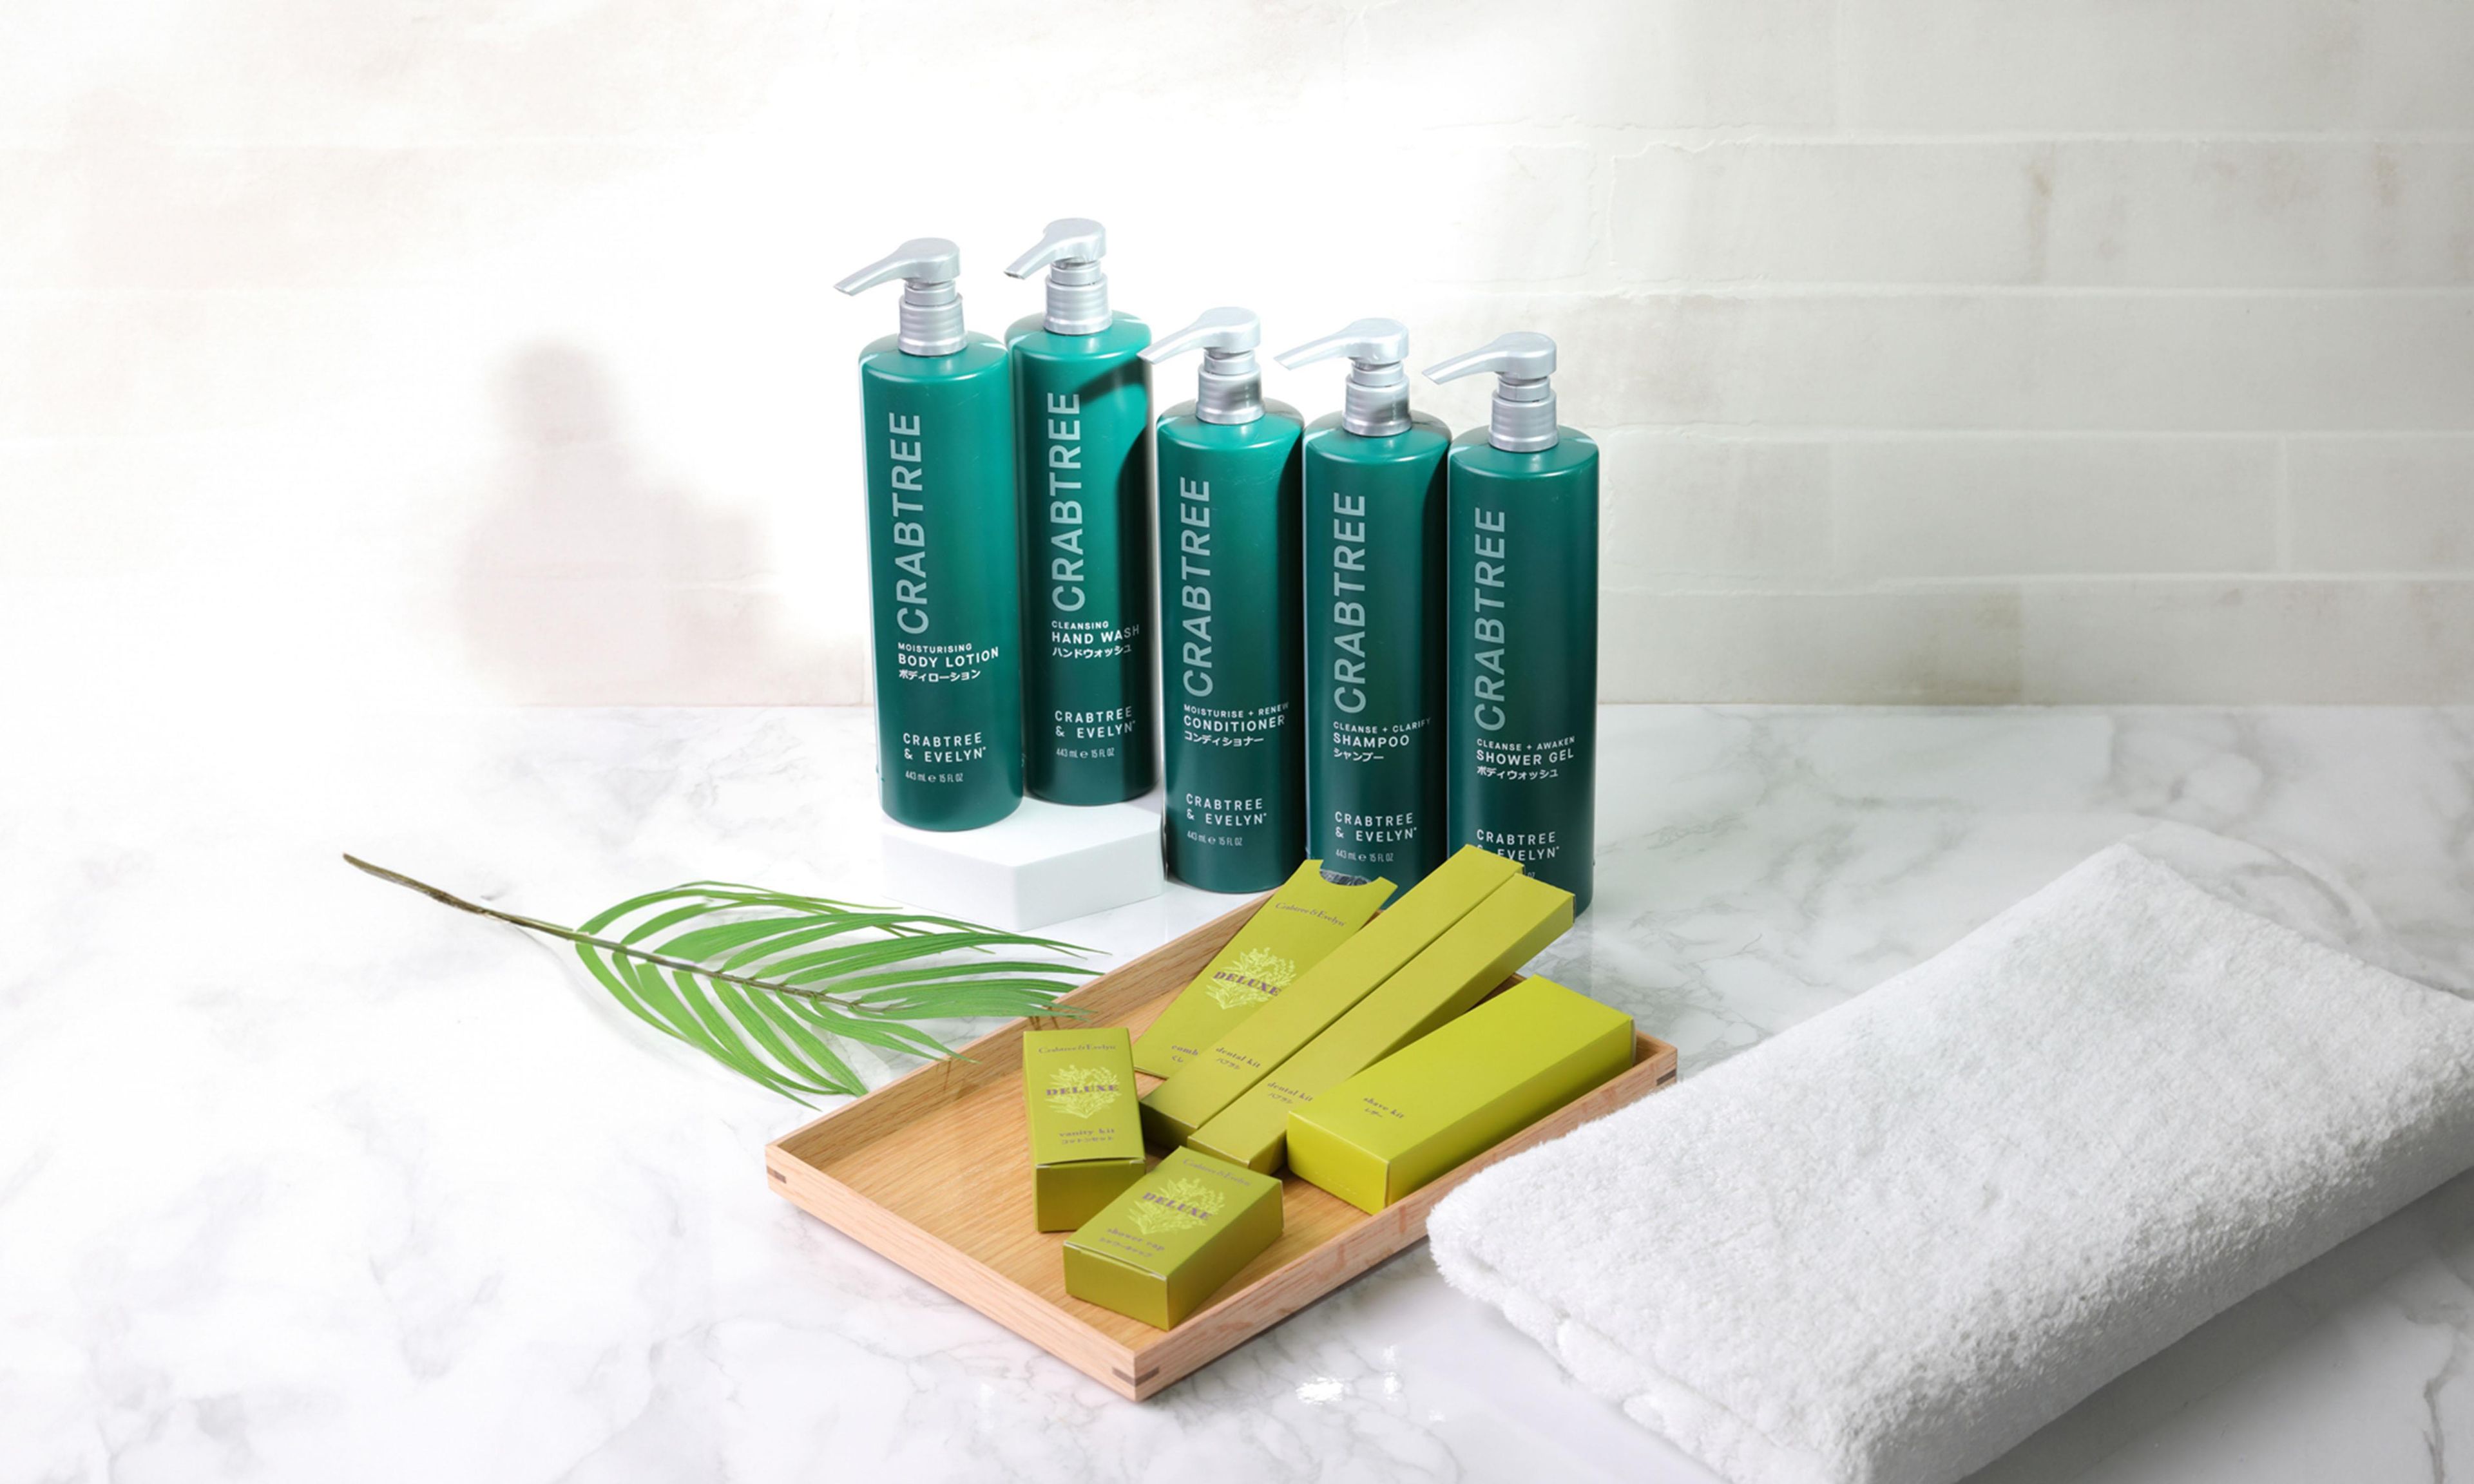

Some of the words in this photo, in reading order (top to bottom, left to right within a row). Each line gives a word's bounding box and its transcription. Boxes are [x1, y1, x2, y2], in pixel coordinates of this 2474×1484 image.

[1048, 392, 1086, 612] CRABTREE
[889, 412, 929, 634] CRABTREE
[1180, 477, 1213, 698] CRABTREE
[1334, 492, 1366, 714] CRABTREE
[1051, 620, 1109, 630] CLEANSING
[1475, 508, 1506, 732] CRABTREE
[1051, 631, 1094, 645] HAND
[1100, 624, 1140, 643] WASH
[897, 642, 972, 654] MOISTURISING
[898, 653, 938, 668] BODY
[946, 646, 999, 668] LOTION
[1052, 645, 1132, 659] ハンドウォッシュ
[899, 669, 981, 683] ボディローション
[1055, 706, 1132, 723] CRABTREE
[1184, 703, 1244, 718] MOISTURISE
[1258, 701, 1289, 716] RENEW
[1055, 725, 1065, 737] &
[1077, 721, 1133, 739] EVELYN
[1184, 714, 1285, 732] CONDITIONER
[1333, 721, 1377, 734] CLEANSE
[1392, 717, 1432, 733] CLARIFY
[903, 732, 983, 748] CRABTREE
[1184, 730, 1264, 747] コンディショナー
[1333, 732, 1410, 748] SHAMPOO
[1477, 738, 1522, 751] CLEANSE
[1537, 736, 1575, 750] AWAKEN
[904, 748, 913, 760] &
[925, 747, 983, 763] EVELYN
[1333, 748, 1385, 762] シャンプー
[1476, 749, 1542, 766] SHOWER
[1549, 748, 1574, 763] GEL
[1477, 766, 1558, 780] ボディウォッシュ
[1186, 793, 1263, 812] CRABTREE
[1187, 808, 1194, 821] &
[1205, 813, 1263, 826] EVELYN
[1335, 811, 1414, 827] CRABTREE
[1335, 826, 1345, 839] &
[1356, 828, 1414, 842] EVELYN
[1477, 828, 1556, 846] CRABTREE
[1275, 902, 1309, 914] Crabtree
[1317, 910, 1345, 927] Evelyn
[1213, 971, 1282, 997] DELUXE
[1171, 1045, 1199, 1056] comb
[1216, 1047, 1247, 1061] dental
[1247, 1058, 1261, 1069] kit
[1046, 1085, 1118, 1096] DELUXE
[1267, 1082, 1299, 1096] dental
[1299, 1092, 1313, 1102] kit
[1363, 1098, 1388, 1110] shave
[1390, 1109, 1404, 1119] kit
[1142, 1192, 1213, 1221] DELUXE
[1107, 1226, 1144, 1242] shower
[1146, 1238, 1165, 1251] cap
